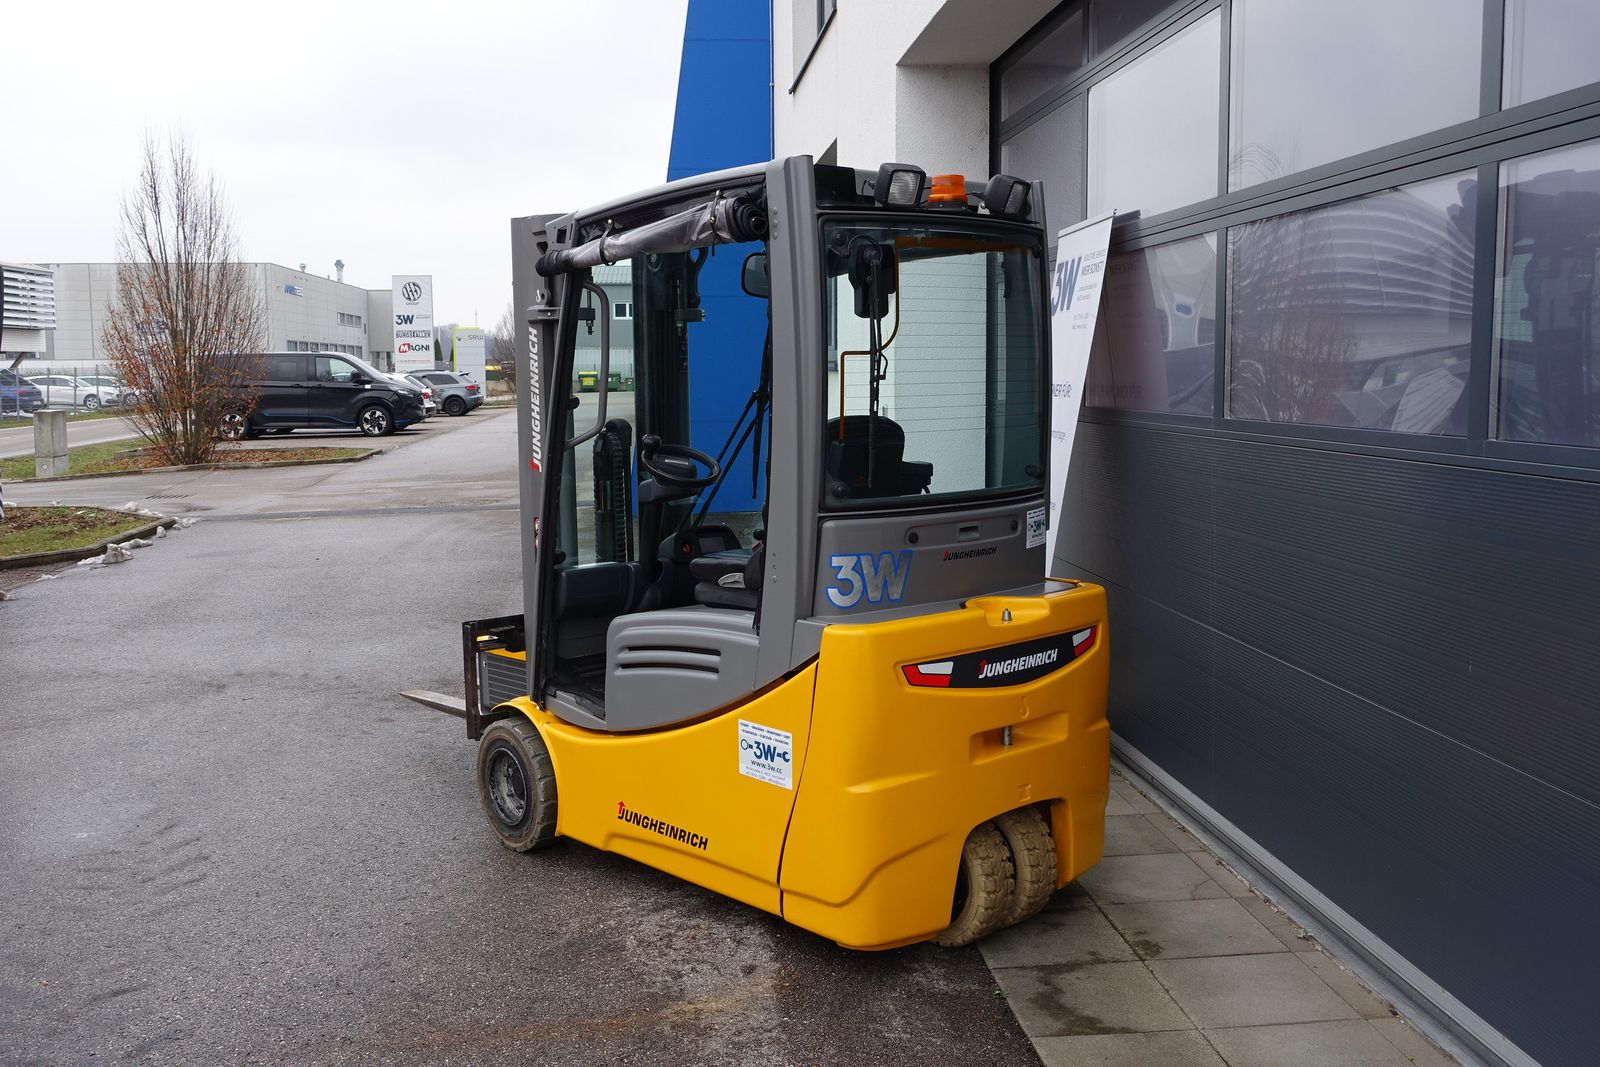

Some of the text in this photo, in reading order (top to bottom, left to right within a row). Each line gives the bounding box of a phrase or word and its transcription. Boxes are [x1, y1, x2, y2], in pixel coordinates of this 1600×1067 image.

[1051, 256, 1082, 316] 3W
[395, 314, 414, 325] 3W
[399, 343, 430, 352] MAGNI
[528, 327, 542, 472] JUNGHEINRICH
[943, 546, 997, 561] JUNGHEINRICH
[826, 550, 913, 609] 3W
[978, 648, 1058, 679] JUNGHEINRICH
[754, 741, 777, 763] 3W
[751, 760, 783, 774] www.3w.cc
[617, 803, 709, 850] JUNGHEINRICH
